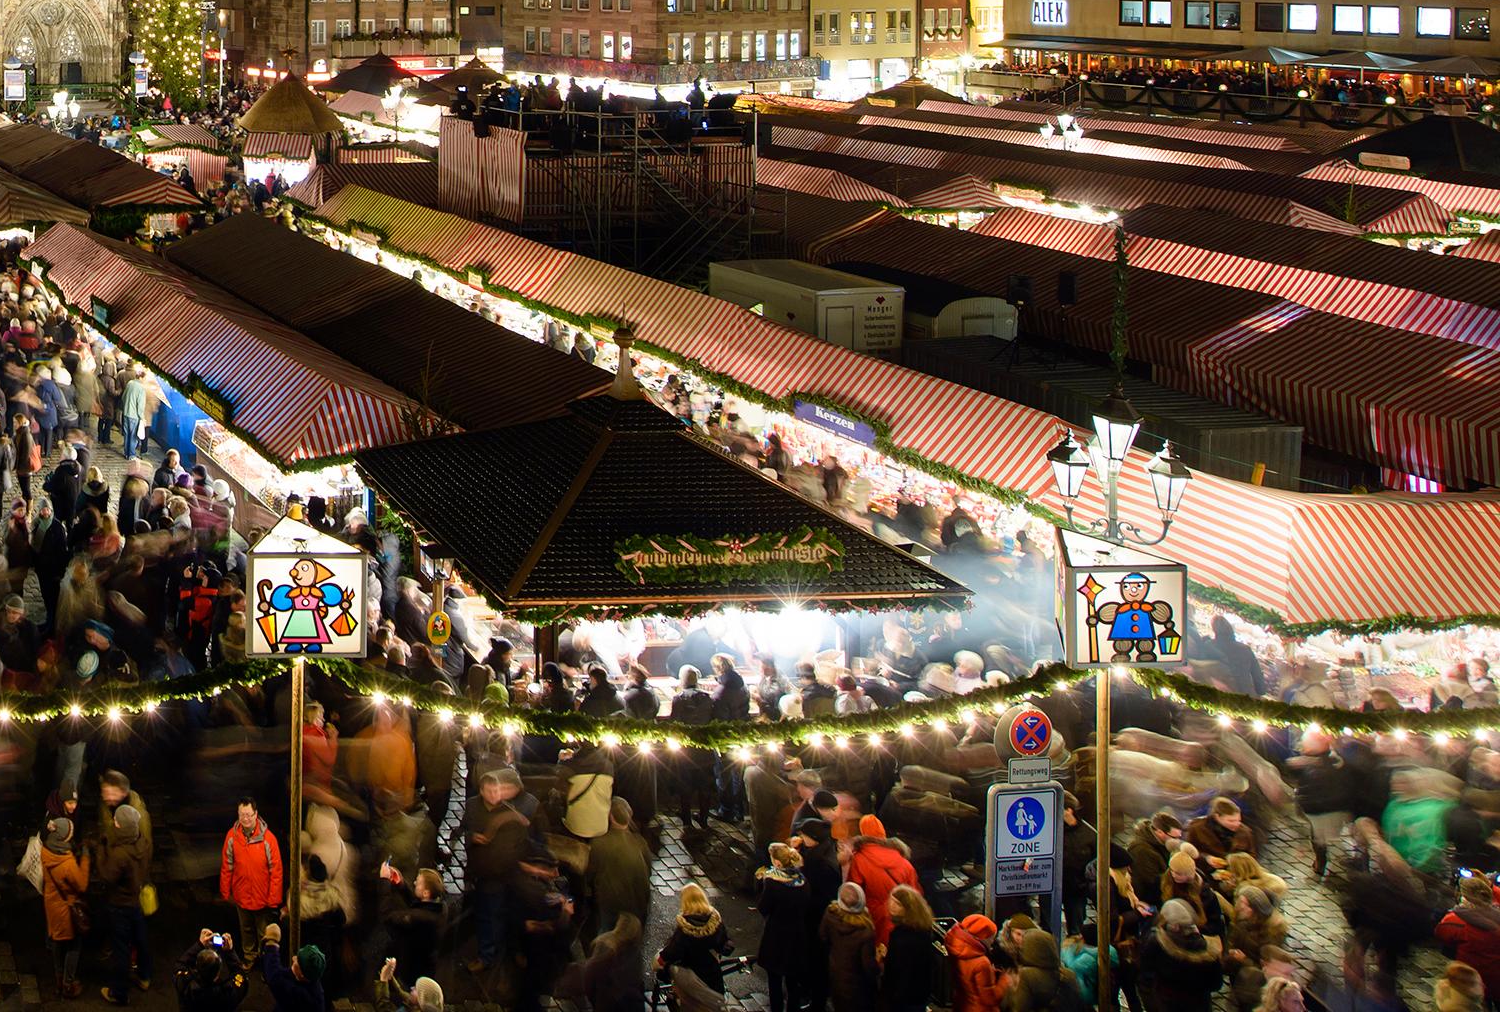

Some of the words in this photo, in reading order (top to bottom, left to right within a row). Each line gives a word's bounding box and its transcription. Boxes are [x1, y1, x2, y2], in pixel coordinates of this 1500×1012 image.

[1033, 1, 1063, 23] ALEX
[815, 405, 855, 431] Kerzen
[1012, 767, 1048, 777] Rettungsweg
[1011, 842, 1040, 853] ZONE
